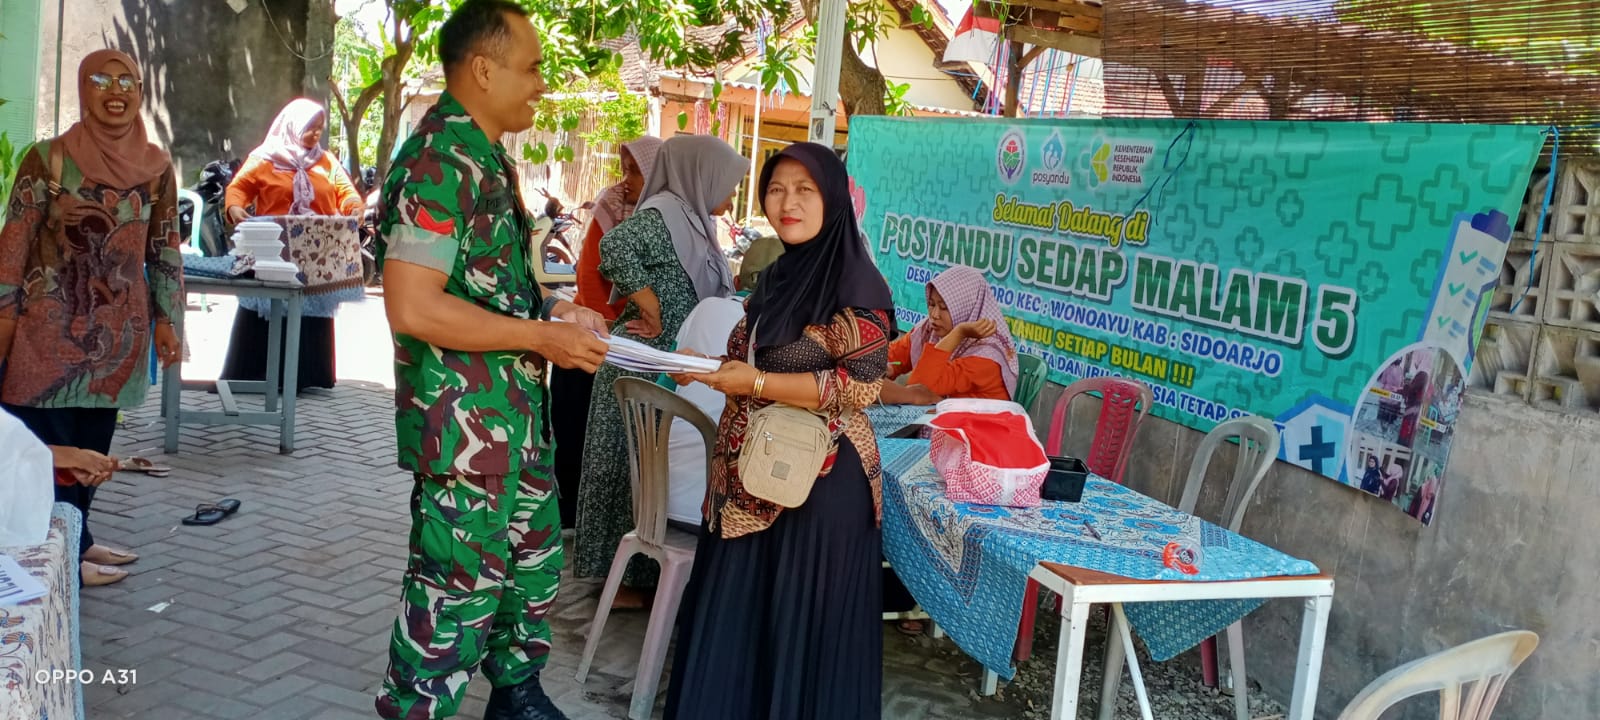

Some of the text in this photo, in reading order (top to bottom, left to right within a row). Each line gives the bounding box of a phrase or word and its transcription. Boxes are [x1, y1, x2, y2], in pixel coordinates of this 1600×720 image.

[1114, 154, 1144, 164] KESEHATAN
[1115, 144, 1153, 154] KEMENTERIAN
[1033, 172, 1070, 185] posyandu
[1112, 174, 1141, 184] INDONESIA
[1113, 164, 1138, 174] REPUBLIK
[993, 195, 1147, 246] Selamat Datang di
[881, 214, 1352, 351] POSYANDU SEDAP MALAM 5
[907, 266, 931, 283] DESA
[1018, 292, 1041, 312] KEC
[1051, 300, 1130, 334] WONOAYU
[1132, 321, 1167, 345] KAB
[1181, 331, 1281, 375] SIDOARJO
[1056, 331, 1107, 360] SETIAP
[1111, 346, 1167, 379] BULAN
[1057, 356, 1082, 376] DAN
[1180, 394, 1227, 421] TETAP
